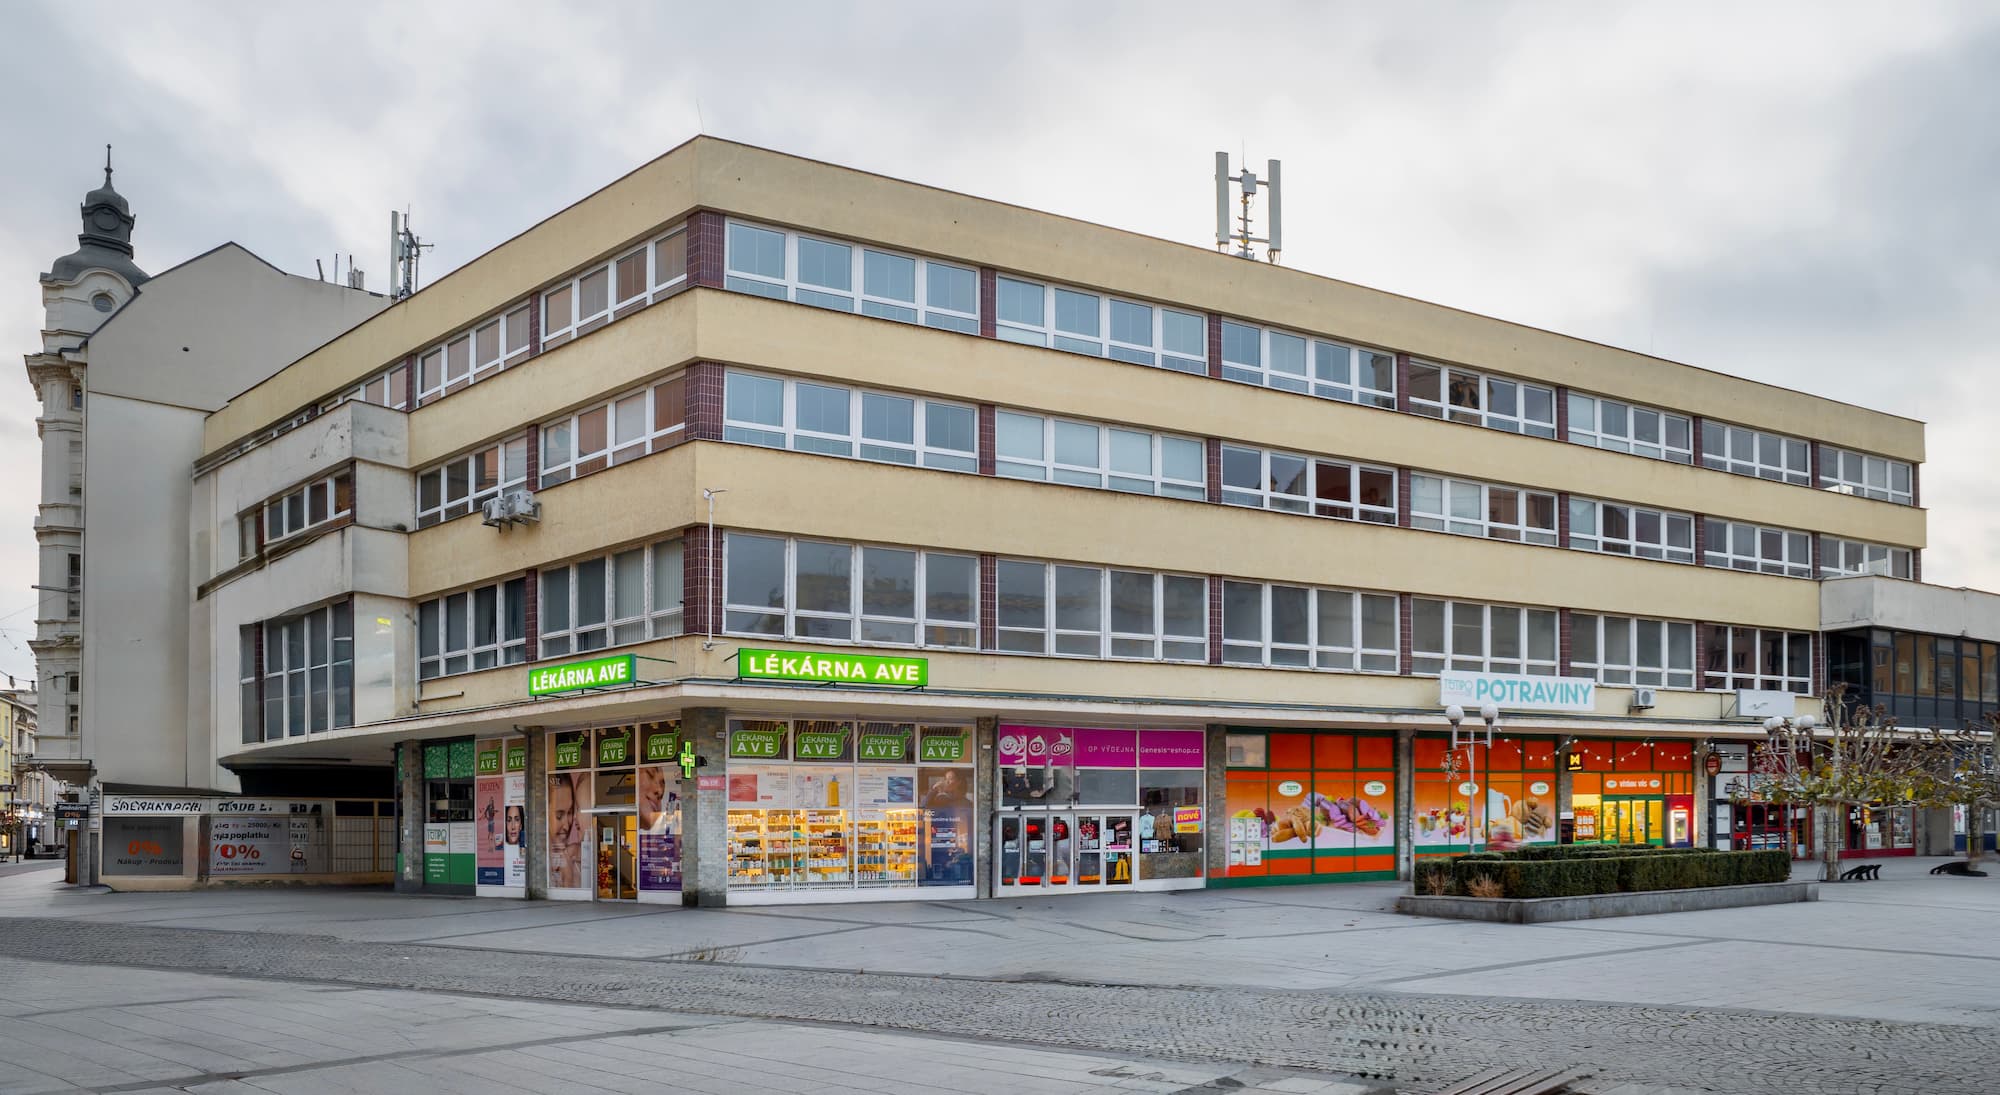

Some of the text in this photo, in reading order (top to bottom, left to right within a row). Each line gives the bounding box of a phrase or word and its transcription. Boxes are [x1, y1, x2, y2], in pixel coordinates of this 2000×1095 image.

[749, 654, 919, 681] LÉKÁRNA AVE
[533, 661, 627, 692] LÉKÁRNA AVE
[1476, 678, 1591, 704] POTRAVINY
[736, 733, 774, 743] LÉKÁRNA
[801, 734, 838, 745] LÉKÁRNA
[866, 736, 900, 746] LÉKÁRNA
[926, 738, 960, 747] LÉKÁRNA
[651, 745, 673, 756] AVE
[736, 742, 774, 753] AVE
[801, 744, 838, 755] AVE
[865, 745, 900, 757] AVE
[926, 747, 960, 758] AVE
[1140, 746, 1200, 755] Genesis-eshop.cz
[558, 753, 578, 764] AVE
[603, 749, 624, 760] AVE
[480, 759, 497, 769] AVE
[1177, 810, 1199, 821] nové
[230, 832, 269, 841] poplatku
[128, 840, 163, 856] 0%
